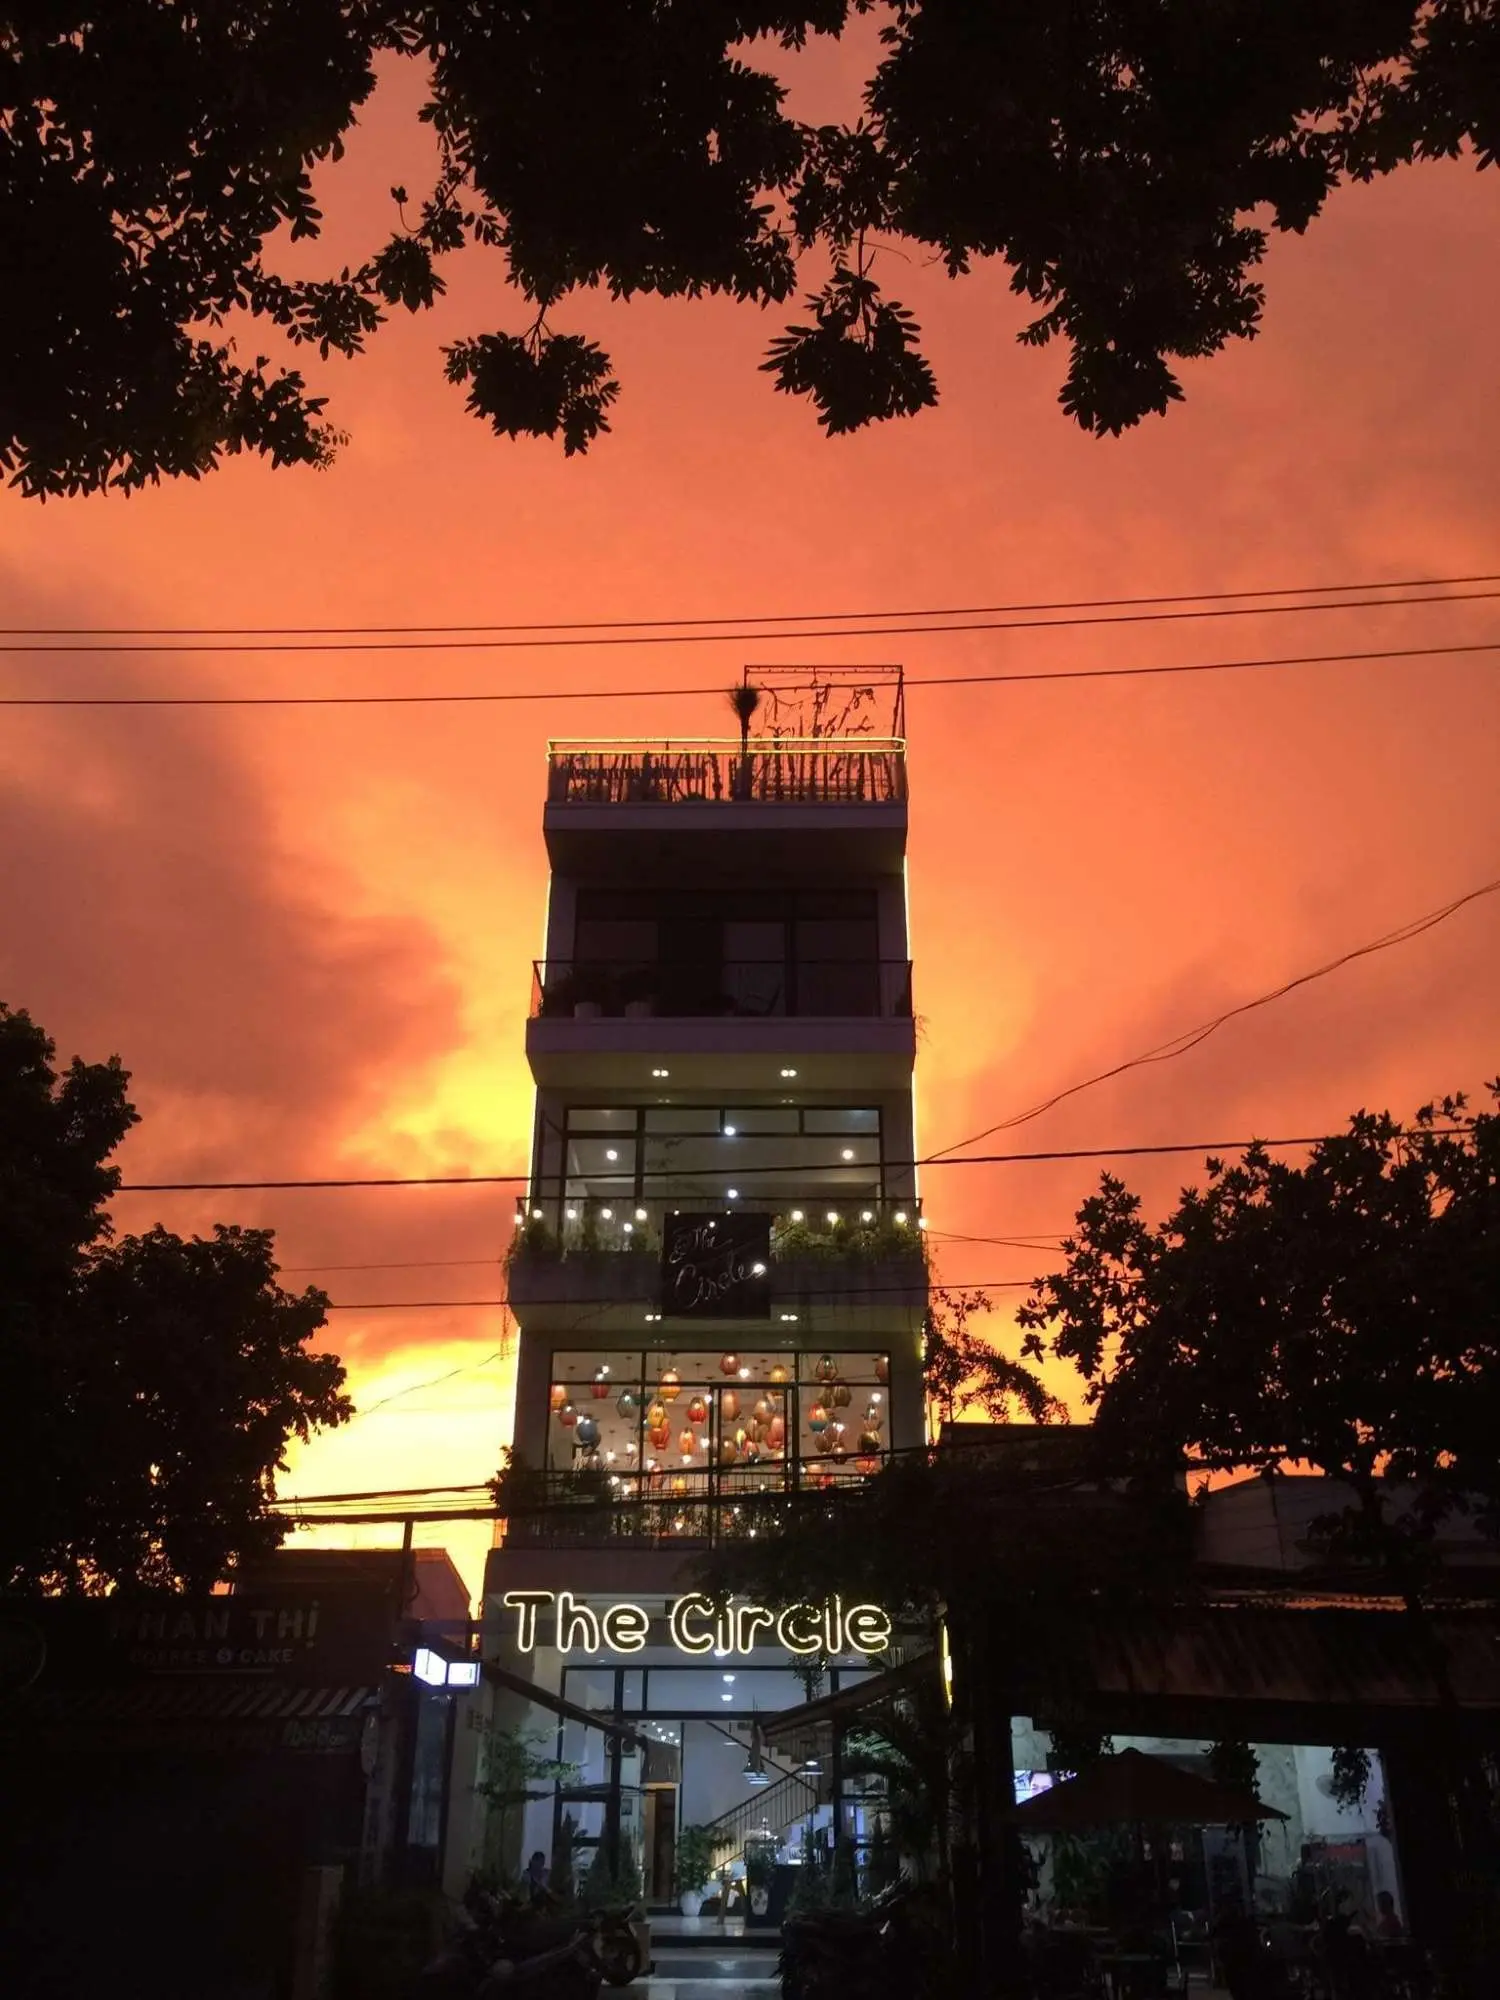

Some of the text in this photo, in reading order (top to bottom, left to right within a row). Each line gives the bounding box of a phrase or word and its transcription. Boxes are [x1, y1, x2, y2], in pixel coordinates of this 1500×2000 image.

[669, 1226, 733, 1264] The
[674, 1249, 764, 1308] Circle
[504, 1590, 893, 1654] The Circle
[240, 1648, 295, 1664] CAKE
